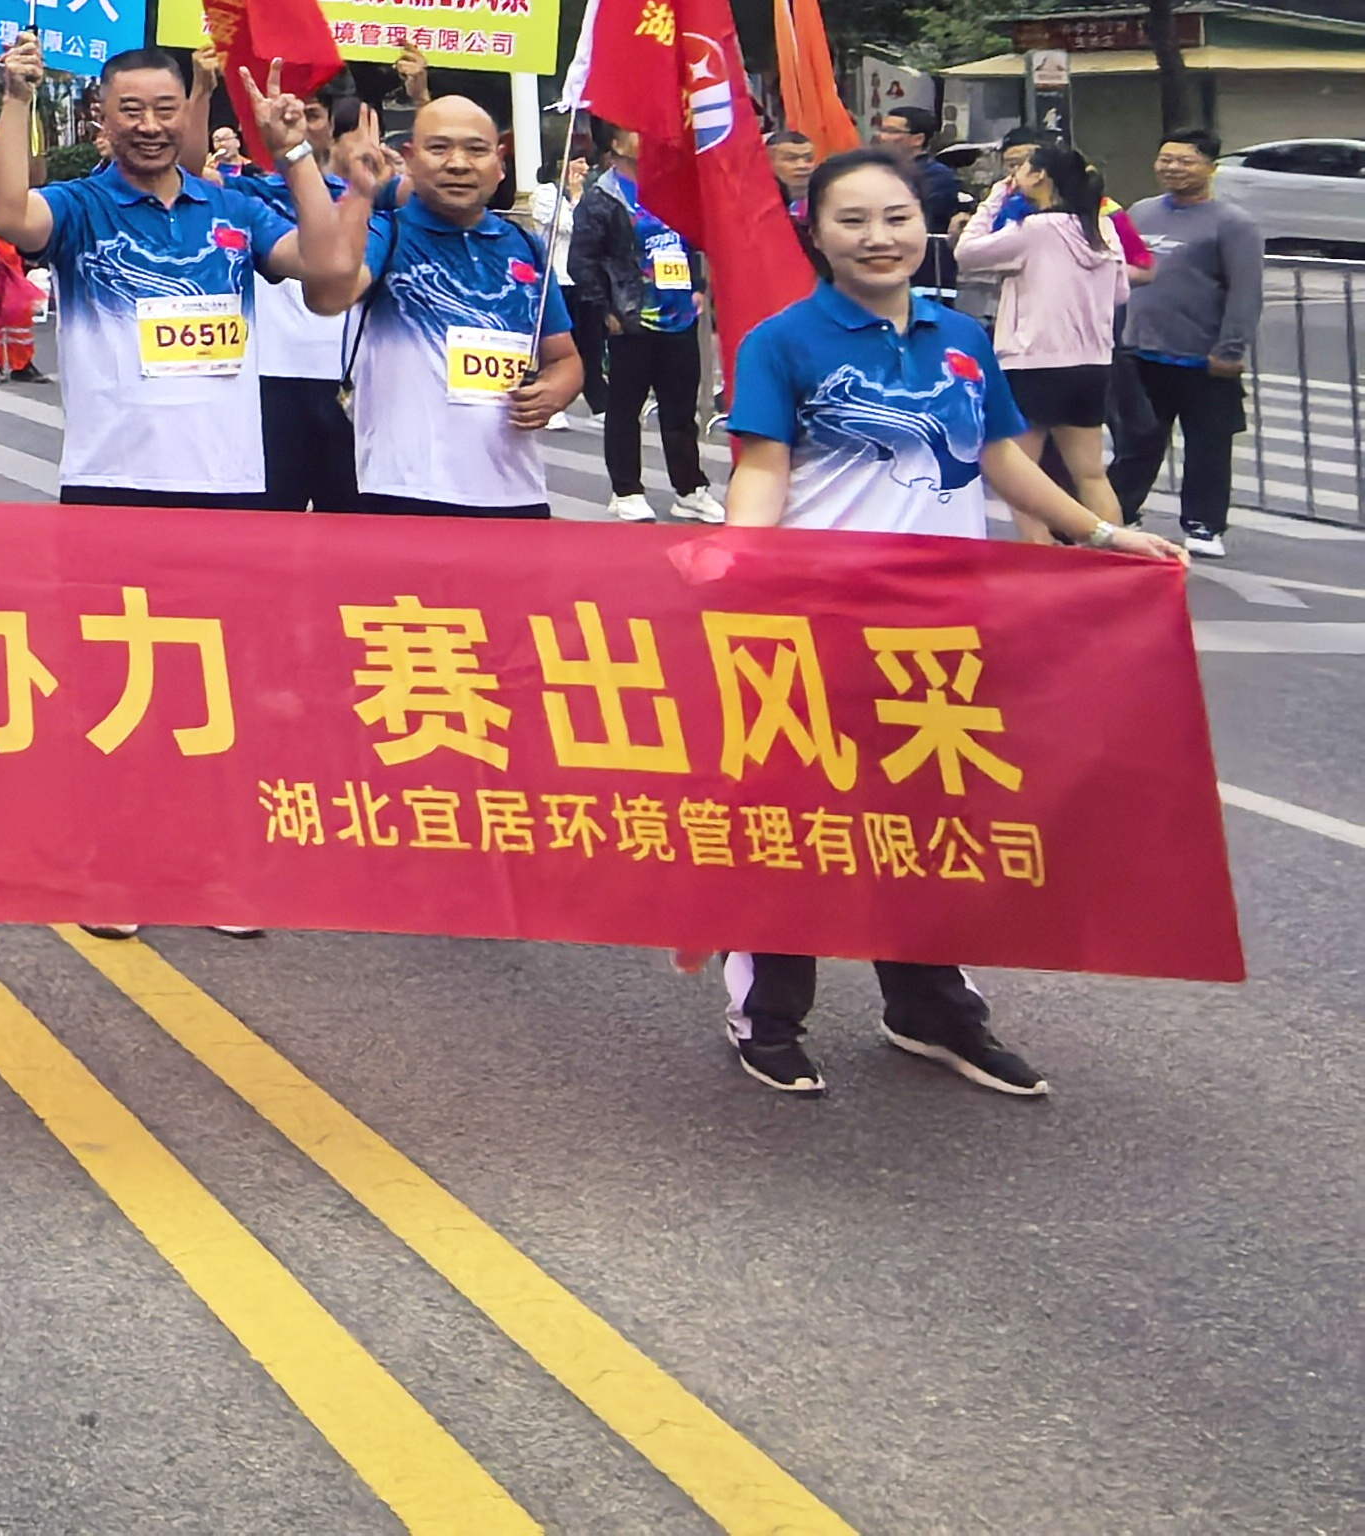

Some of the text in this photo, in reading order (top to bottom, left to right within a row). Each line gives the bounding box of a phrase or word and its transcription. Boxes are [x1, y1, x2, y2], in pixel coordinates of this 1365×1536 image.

[332, 21, 513, 56] 境管理有限公司
[156, 322, 240, 348] D6512
[339, 594, 1024, 797] 赛出风采
[258, 779, 1048, 888] 湖北宜居环境管理有限公司
